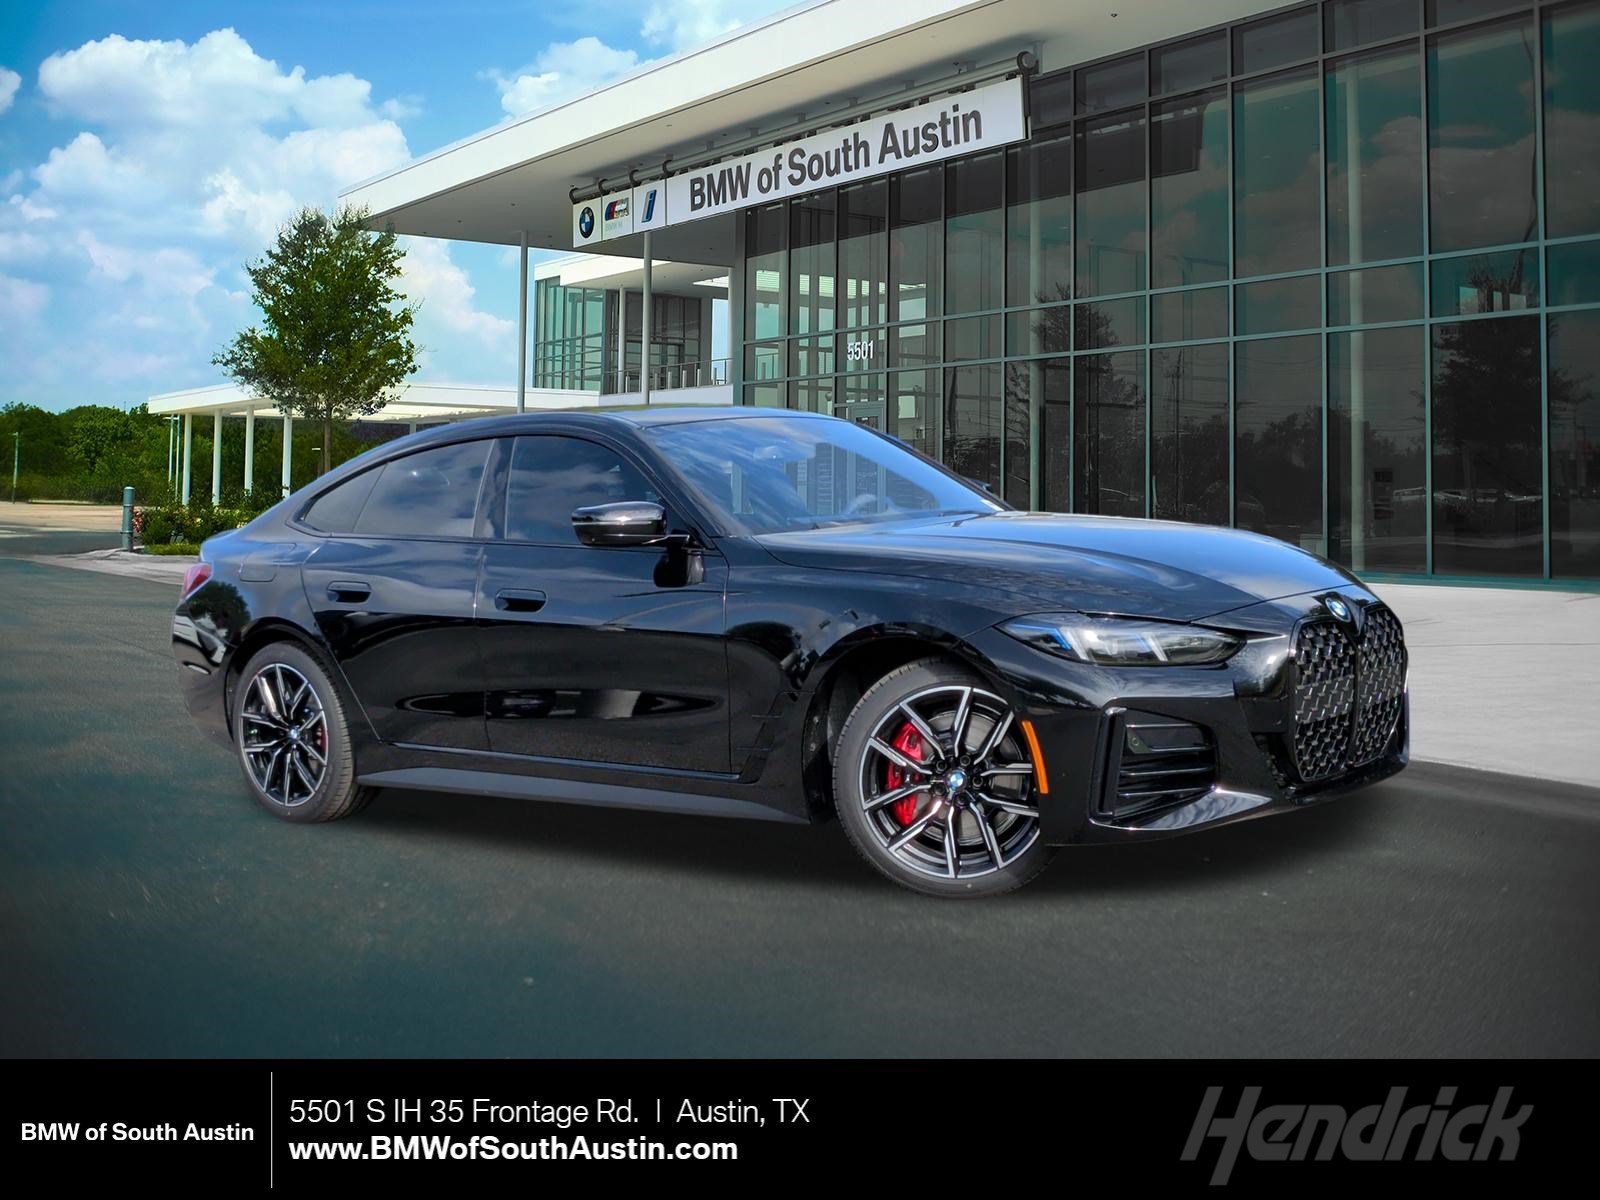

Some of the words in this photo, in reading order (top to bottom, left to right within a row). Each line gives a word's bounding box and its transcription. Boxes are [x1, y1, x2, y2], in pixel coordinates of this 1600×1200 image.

[690, 162, 752, 212] BMW
[757, 153, 783, 194] of
[787, 131, 870, 186] South
[878, 104, 982, 164] Austin
[847, 340, 874, 360] 5501
